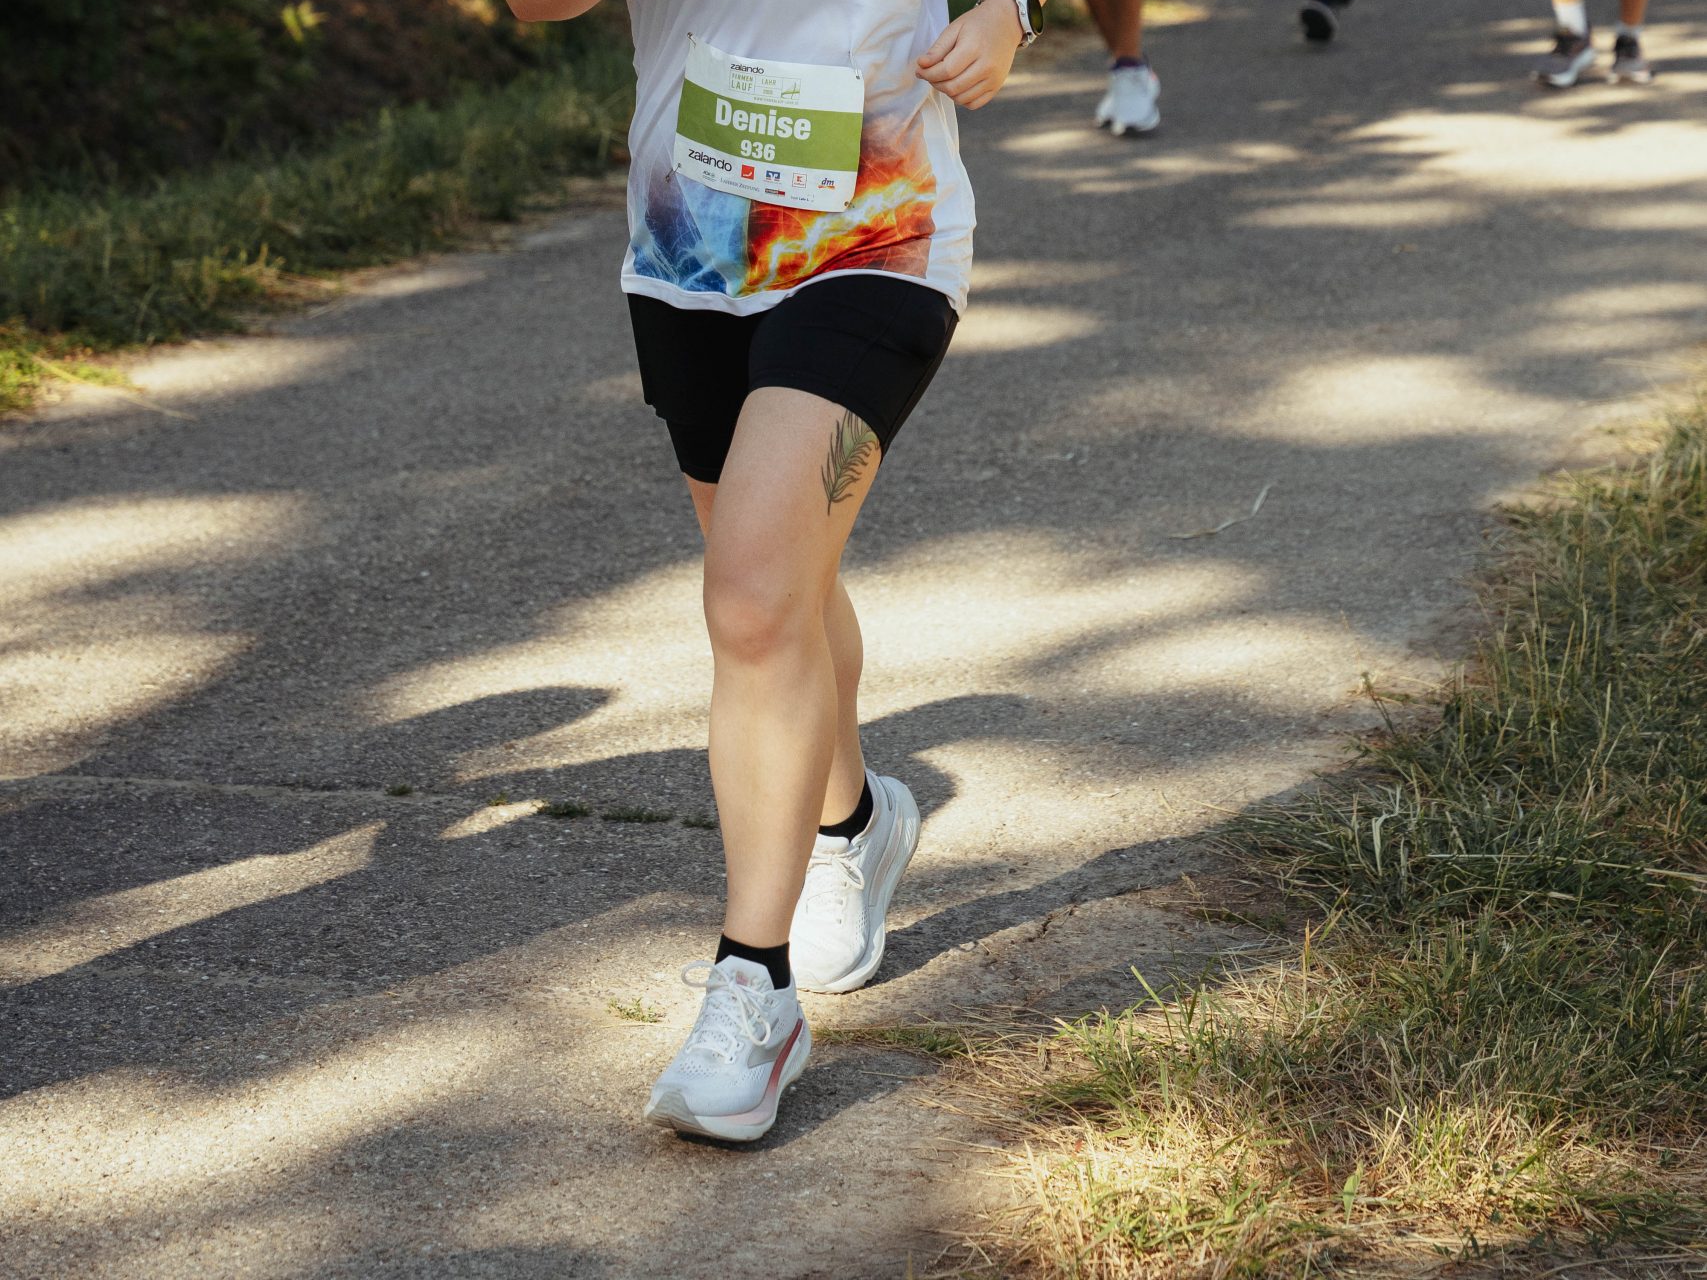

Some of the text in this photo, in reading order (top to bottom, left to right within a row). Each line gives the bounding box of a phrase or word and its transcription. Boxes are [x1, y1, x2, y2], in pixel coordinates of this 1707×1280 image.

[730, 63, 764, 74] zalando
[731, 72, 753, 82] FIRMEN
[761, 78, 777, 86] LAHR
[731, 80, 753, 92] LAUF
[715, 96, 812, 140] Denise
[740, 139, 775, 161] 936
[688, 148, 732, 173] zalando
[821, 177, 835, 186] dm
